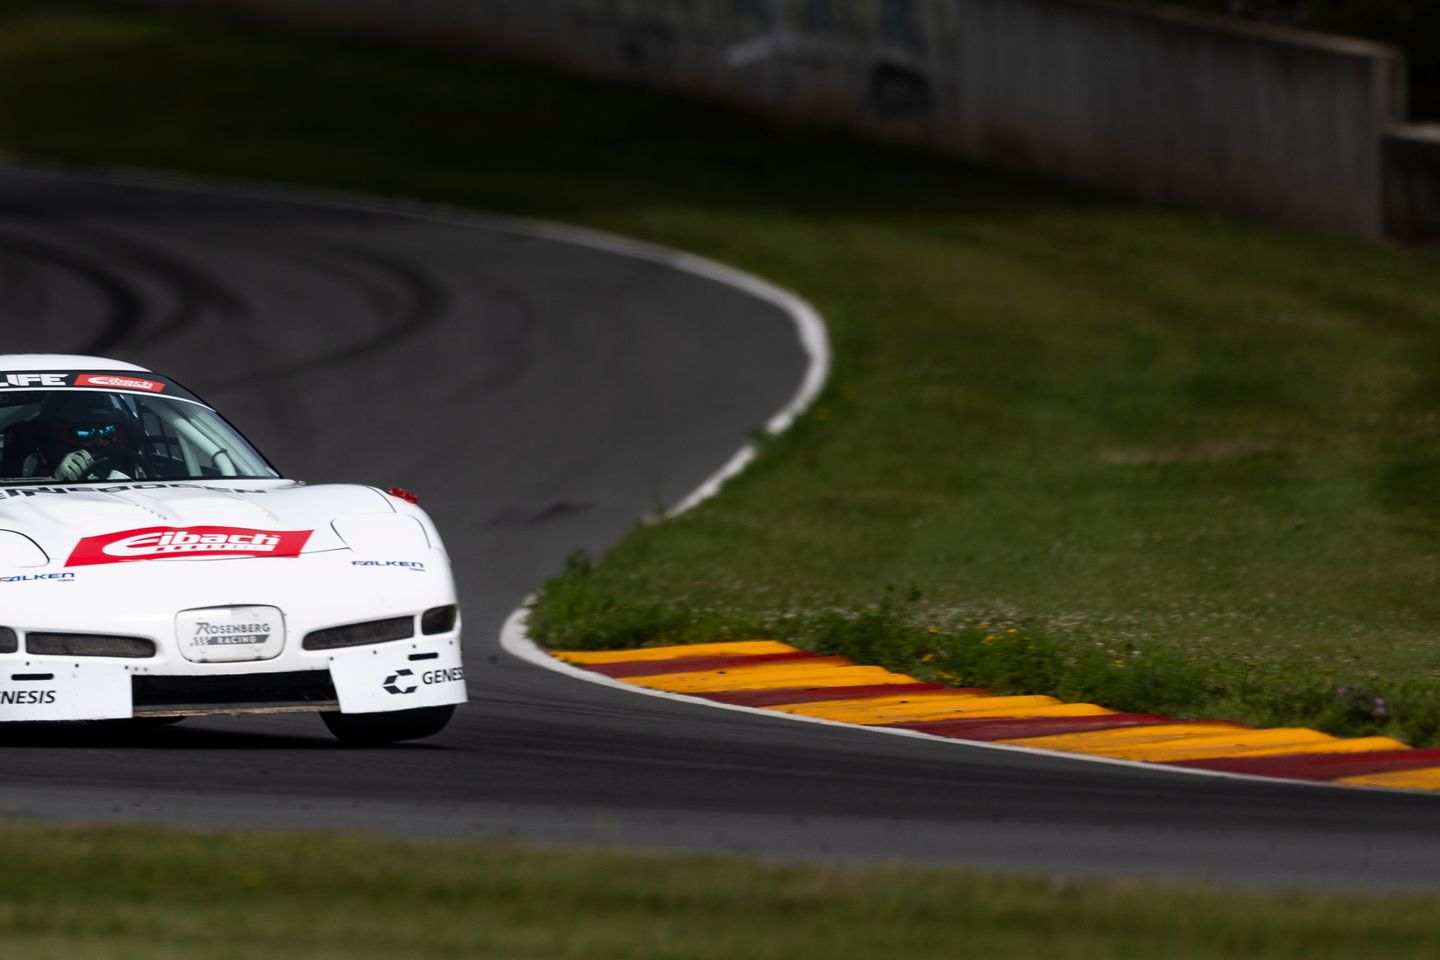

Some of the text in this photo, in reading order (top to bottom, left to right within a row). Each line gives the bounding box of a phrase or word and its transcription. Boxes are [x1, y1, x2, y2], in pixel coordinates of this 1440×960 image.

[102, 531, 280, 557] Eibach
[195, 622, 271, 635] ROSENBERG
[217, 636, 257, 644] RACING
